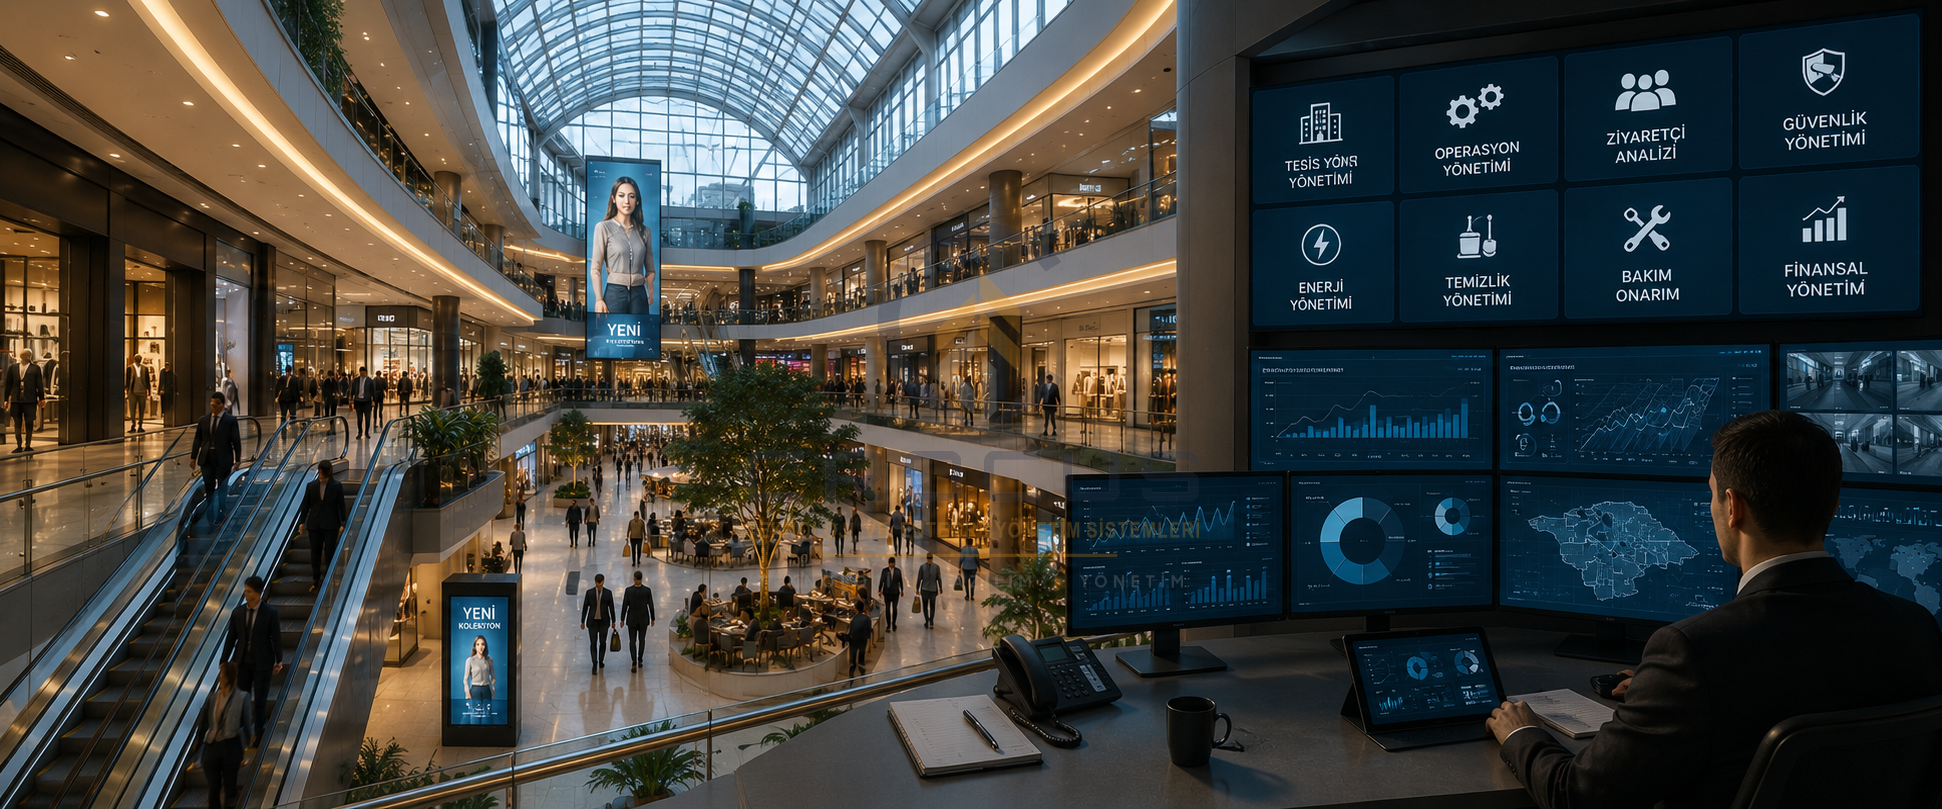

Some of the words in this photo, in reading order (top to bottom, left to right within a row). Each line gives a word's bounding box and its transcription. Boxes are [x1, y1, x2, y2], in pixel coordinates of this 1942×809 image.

[1783, 110, 1866, 130] GÜVENLİK
[1606, 124, 1685, 146] ZİYARETÇİ
[1785, 129, 1866, 150] YÖNETİMİ
[1434, 141, 1520, 159] OPERASYON
[1615, 144, 1676, 163] ANALİZİ
[1443, 158, 1511, 176] YÖNETİMİ
[1289, 170, 1352, 188] YÖNETİMİ
[1622, 269, 1672, 283] BAKIM
[1784, 261, 1869, 277] FİNANSAL
[1299, 279, 1344, 293] ENERJİ
[1445, 273, 1511, 288] TEMİZLİK
[1290, 296, 1352, 310] YÖNETİMİ
[1443, 291, 1512, 307] YÖNETİMİ
[1616, 288, 1680, 302] ONARIM
[607, 321, 641, 336] YENİ
[463, 604, 495, 620] YENİ
